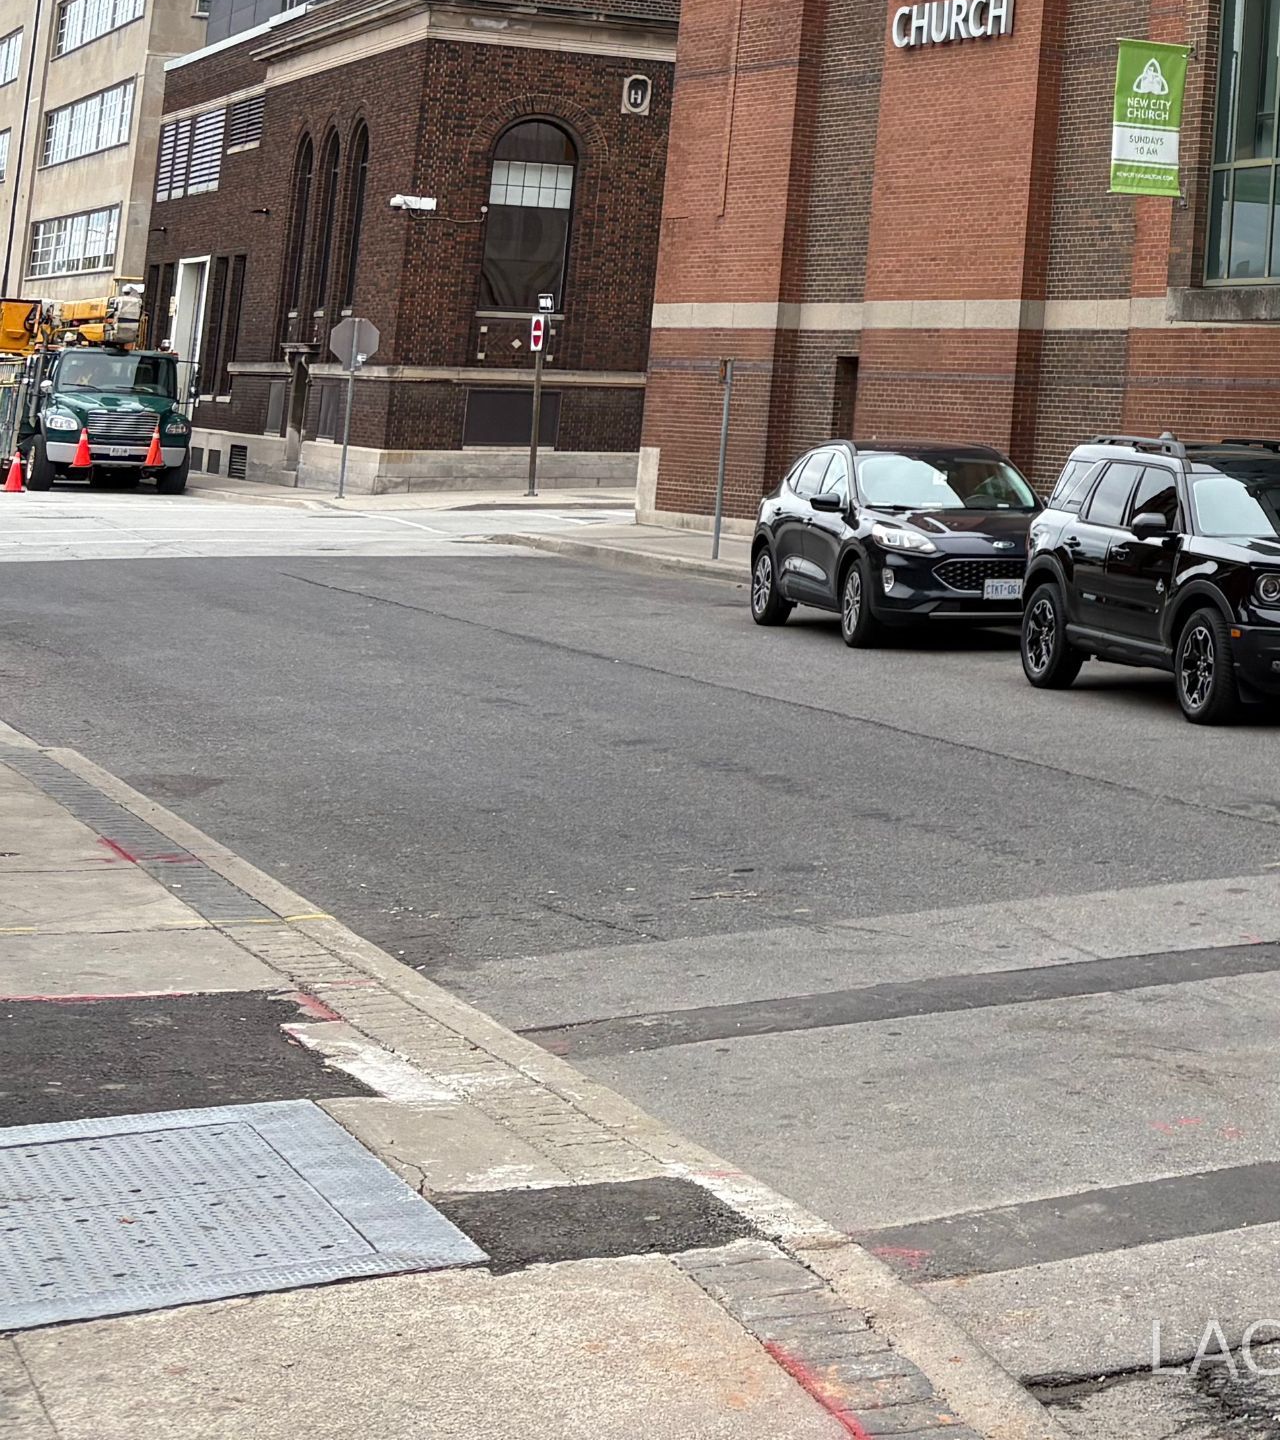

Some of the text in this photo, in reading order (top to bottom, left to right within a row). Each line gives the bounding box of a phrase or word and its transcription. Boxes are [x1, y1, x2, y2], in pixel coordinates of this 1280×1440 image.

[1127, 97, 1172, 110] NEW CITY
[1127, 108, 1169, 120] CHURCH
[1129, 134, 1164, 146] SUNDAYS
[1136, 147, 1158, 156] 10 AM
